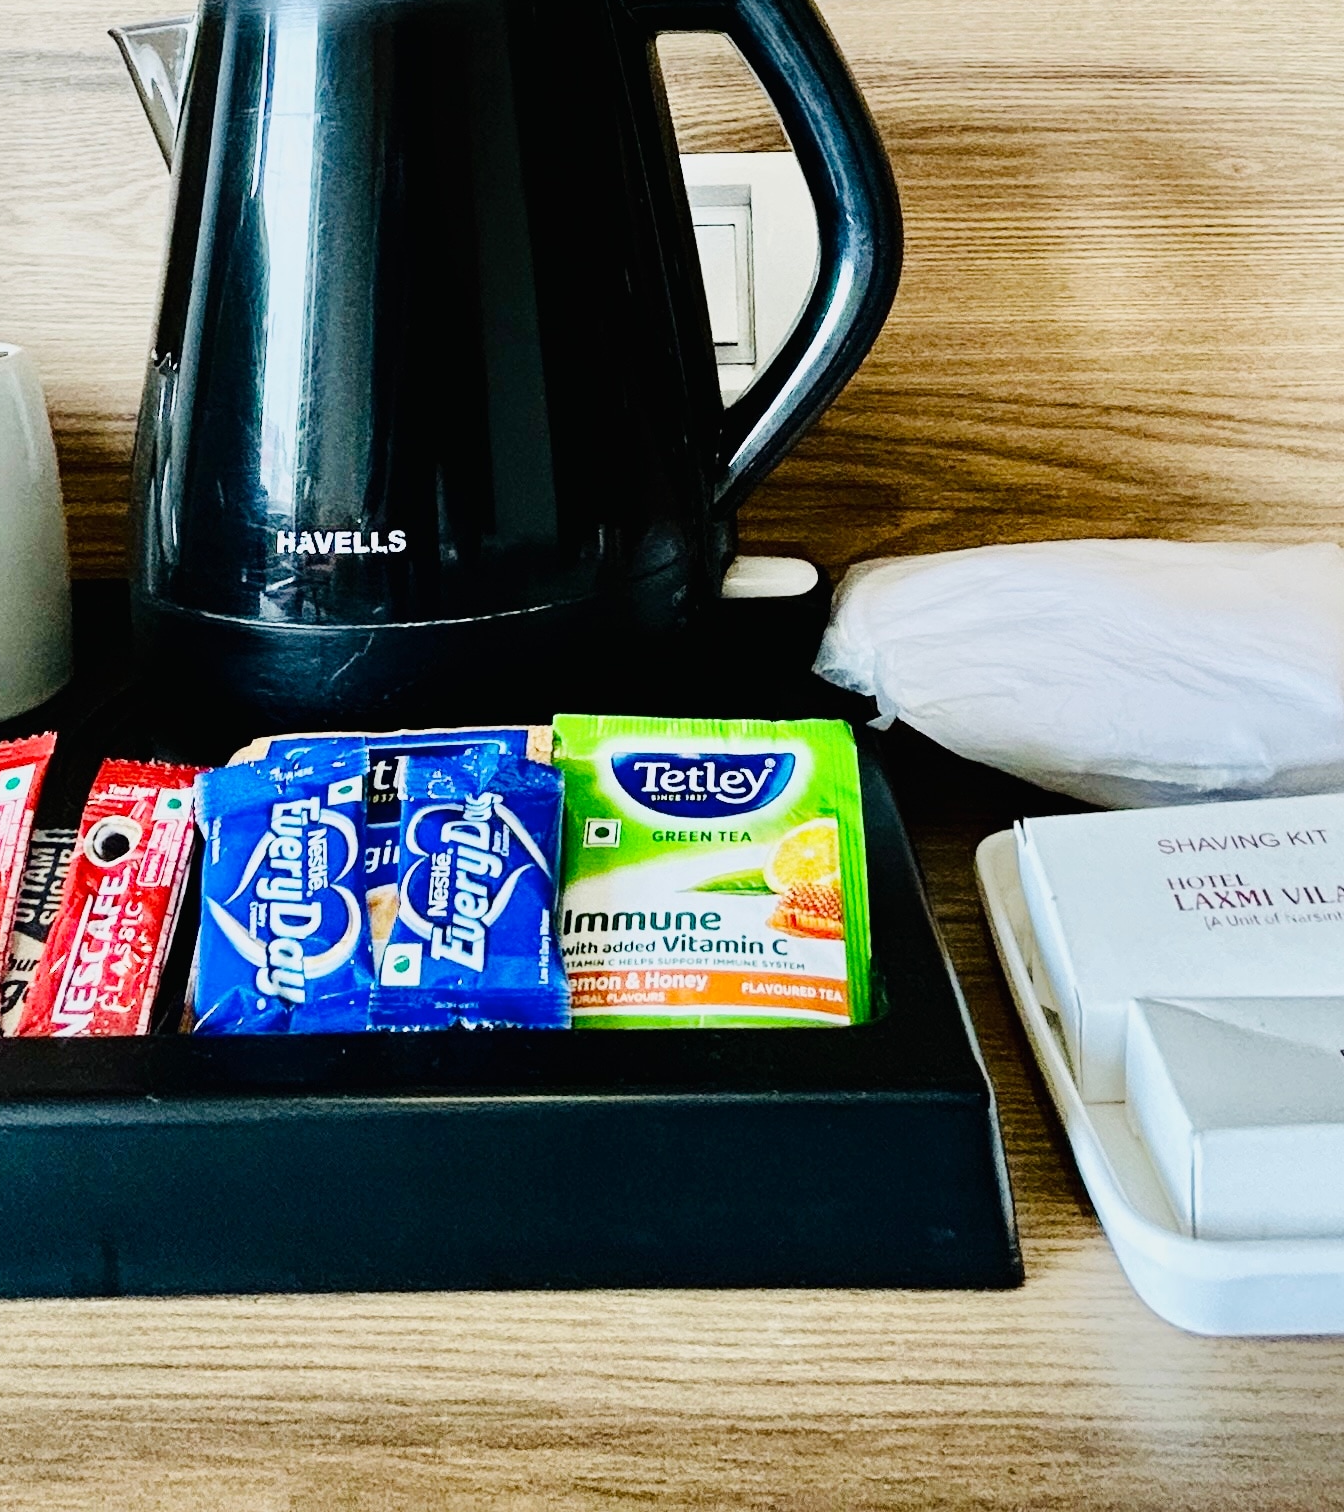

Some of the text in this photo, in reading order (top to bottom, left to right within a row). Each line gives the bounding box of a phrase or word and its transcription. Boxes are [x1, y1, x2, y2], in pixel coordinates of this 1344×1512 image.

[276, 529, 407, 555] HAVELLS
[633, 761, 774, 805] Tetley
[652, 830, 752, 842] GREEN TEA
[1157, 829, 1328, 855] SHAVING KIT
[1166, 873, 1249, 890] HOTEL
[1173, 889, 1274, 911] LAXMI
[563, 908, 722, 936] Immune
[1226, 911, 1260, 928] Unit
[1265, 911, 1280, 925] of
[562, 933, 789, 957] with added Vitamin C
[565, 959, 605, 969] ITAMIN
[619, 958, 654, 966] HELPS
[657, 957, 709, 967] SUPPORT
[713, 958, 758, 968] IMMUNE
[762, 960, 806, 970] SYSTEM
[568, 971, 709, 993] emon & Honey
[741, 982, 844, 1003] FLAVOURED TEA
[570, 991, 666, 1005] TURAL FLAVOURS
